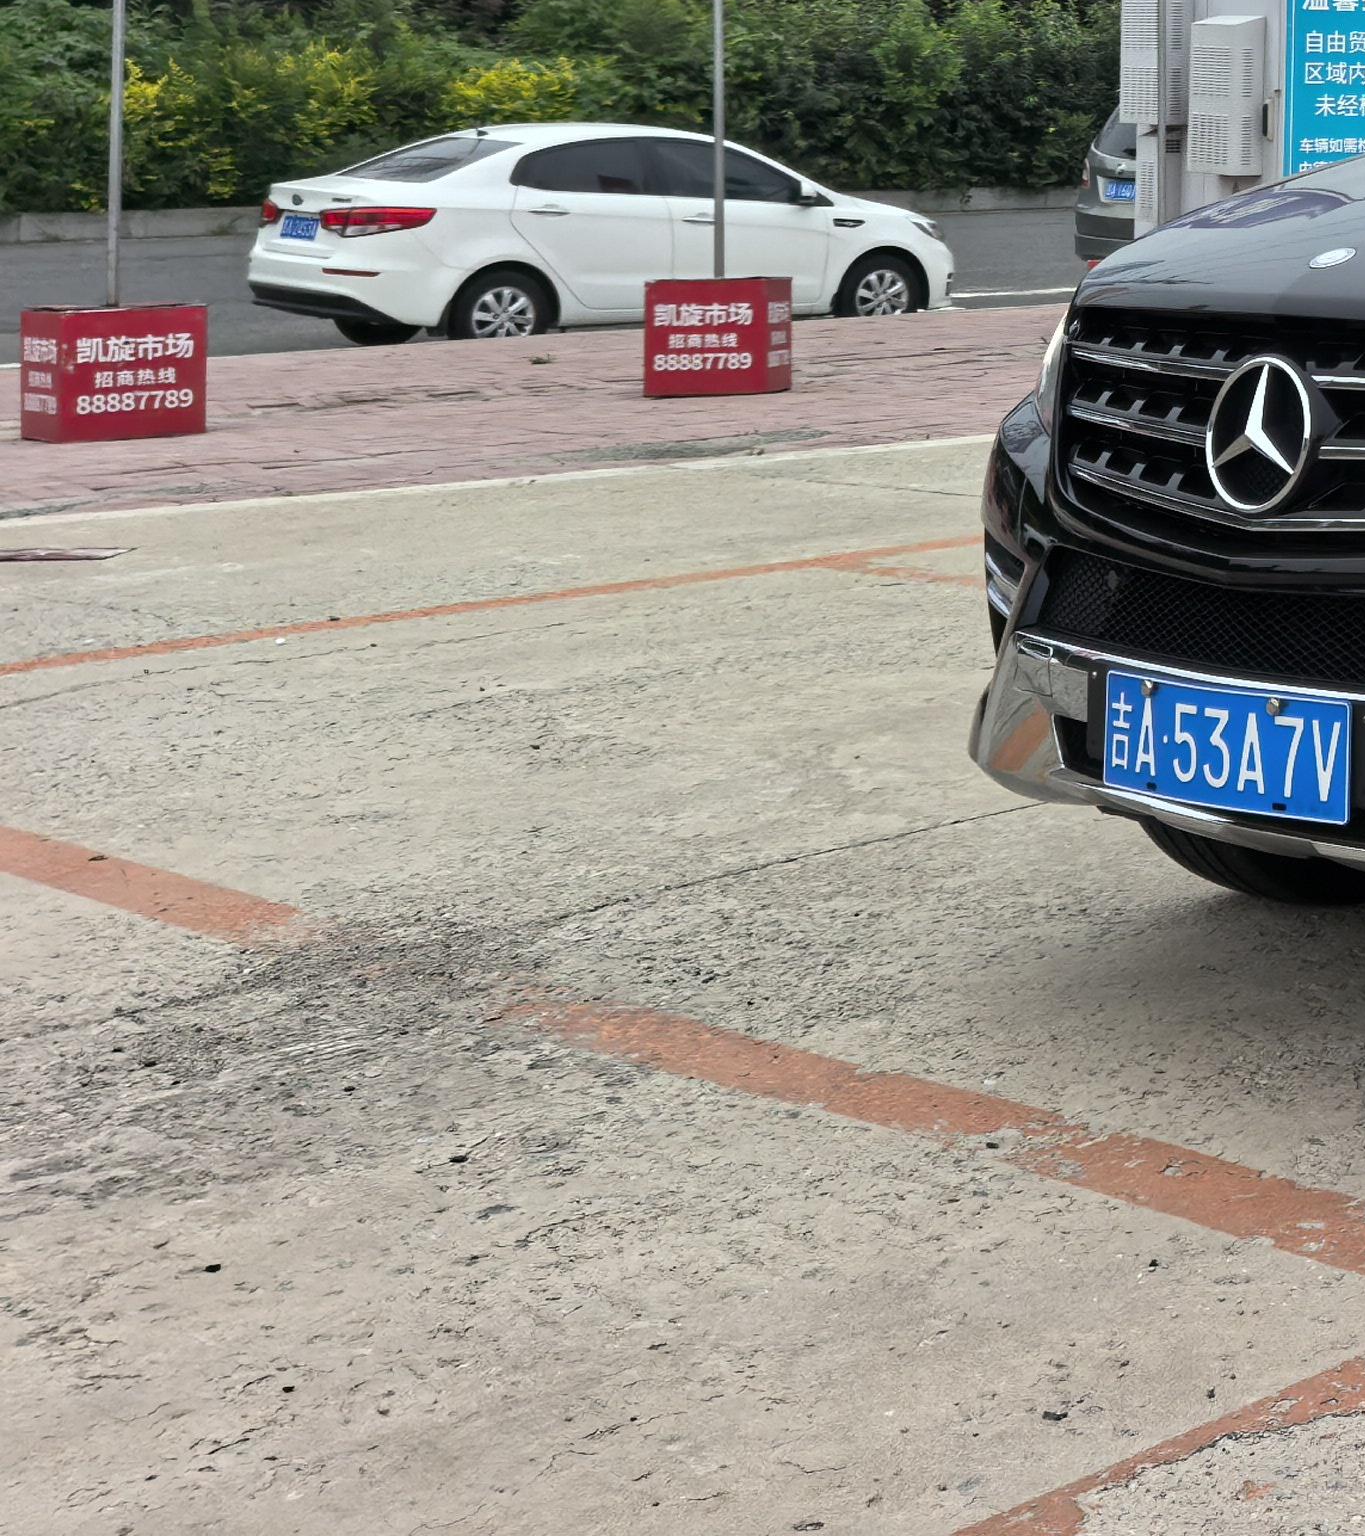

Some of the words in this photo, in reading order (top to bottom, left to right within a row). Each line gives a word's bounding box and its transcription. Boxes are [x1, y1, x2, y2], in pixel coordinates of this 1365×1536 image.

[654, 302, 754, 327] 凯旋市场
[76, 332, 194, 364] 凯旋市场
[668, 332, 738, 349] 招商热线
[653, 352, 753, 372] 88887789
[94, 367, 176, 389] 招商热线
[76, 388, 194, 415] 88887789
[1110, 691, 1342, 803] 吉A·53A7V
